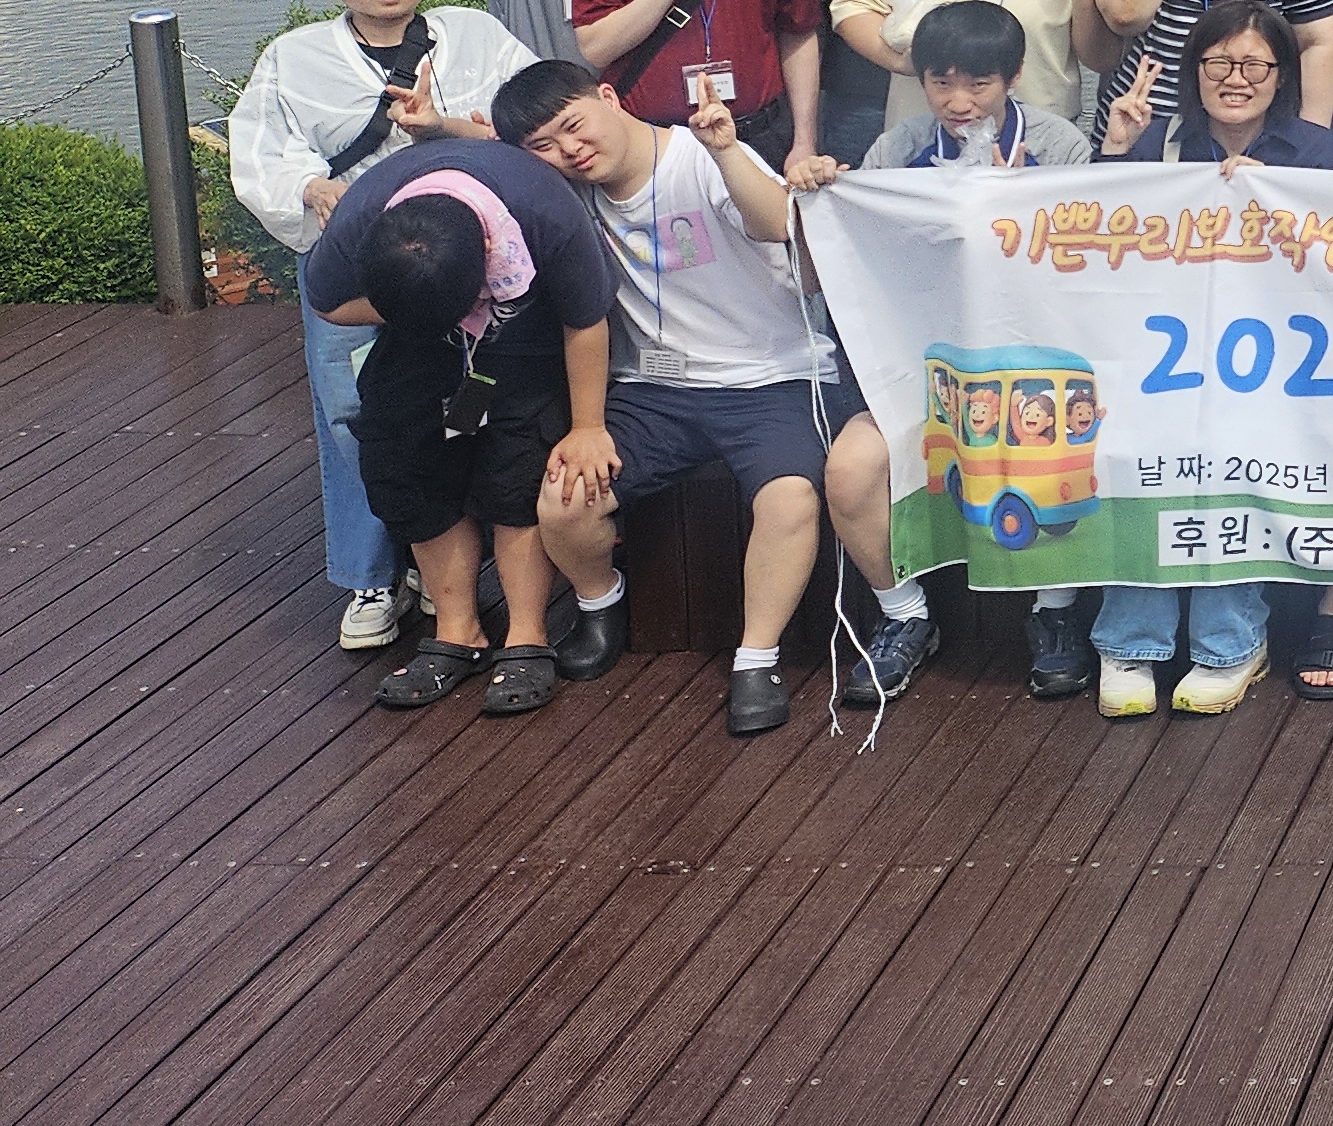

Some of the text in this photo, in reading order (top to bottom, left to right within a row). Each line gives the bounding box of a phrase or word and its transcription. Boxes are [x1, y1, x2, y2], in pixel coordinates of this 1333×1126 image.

[1137, 456, 1166, 487] 날
[1175, 452, 1214, 486] 짜:
[1221, 456, 1329, 494] 2025년
[1171, 516, 1207, 558] 후
[1218, 514, 1250, 556] 원
